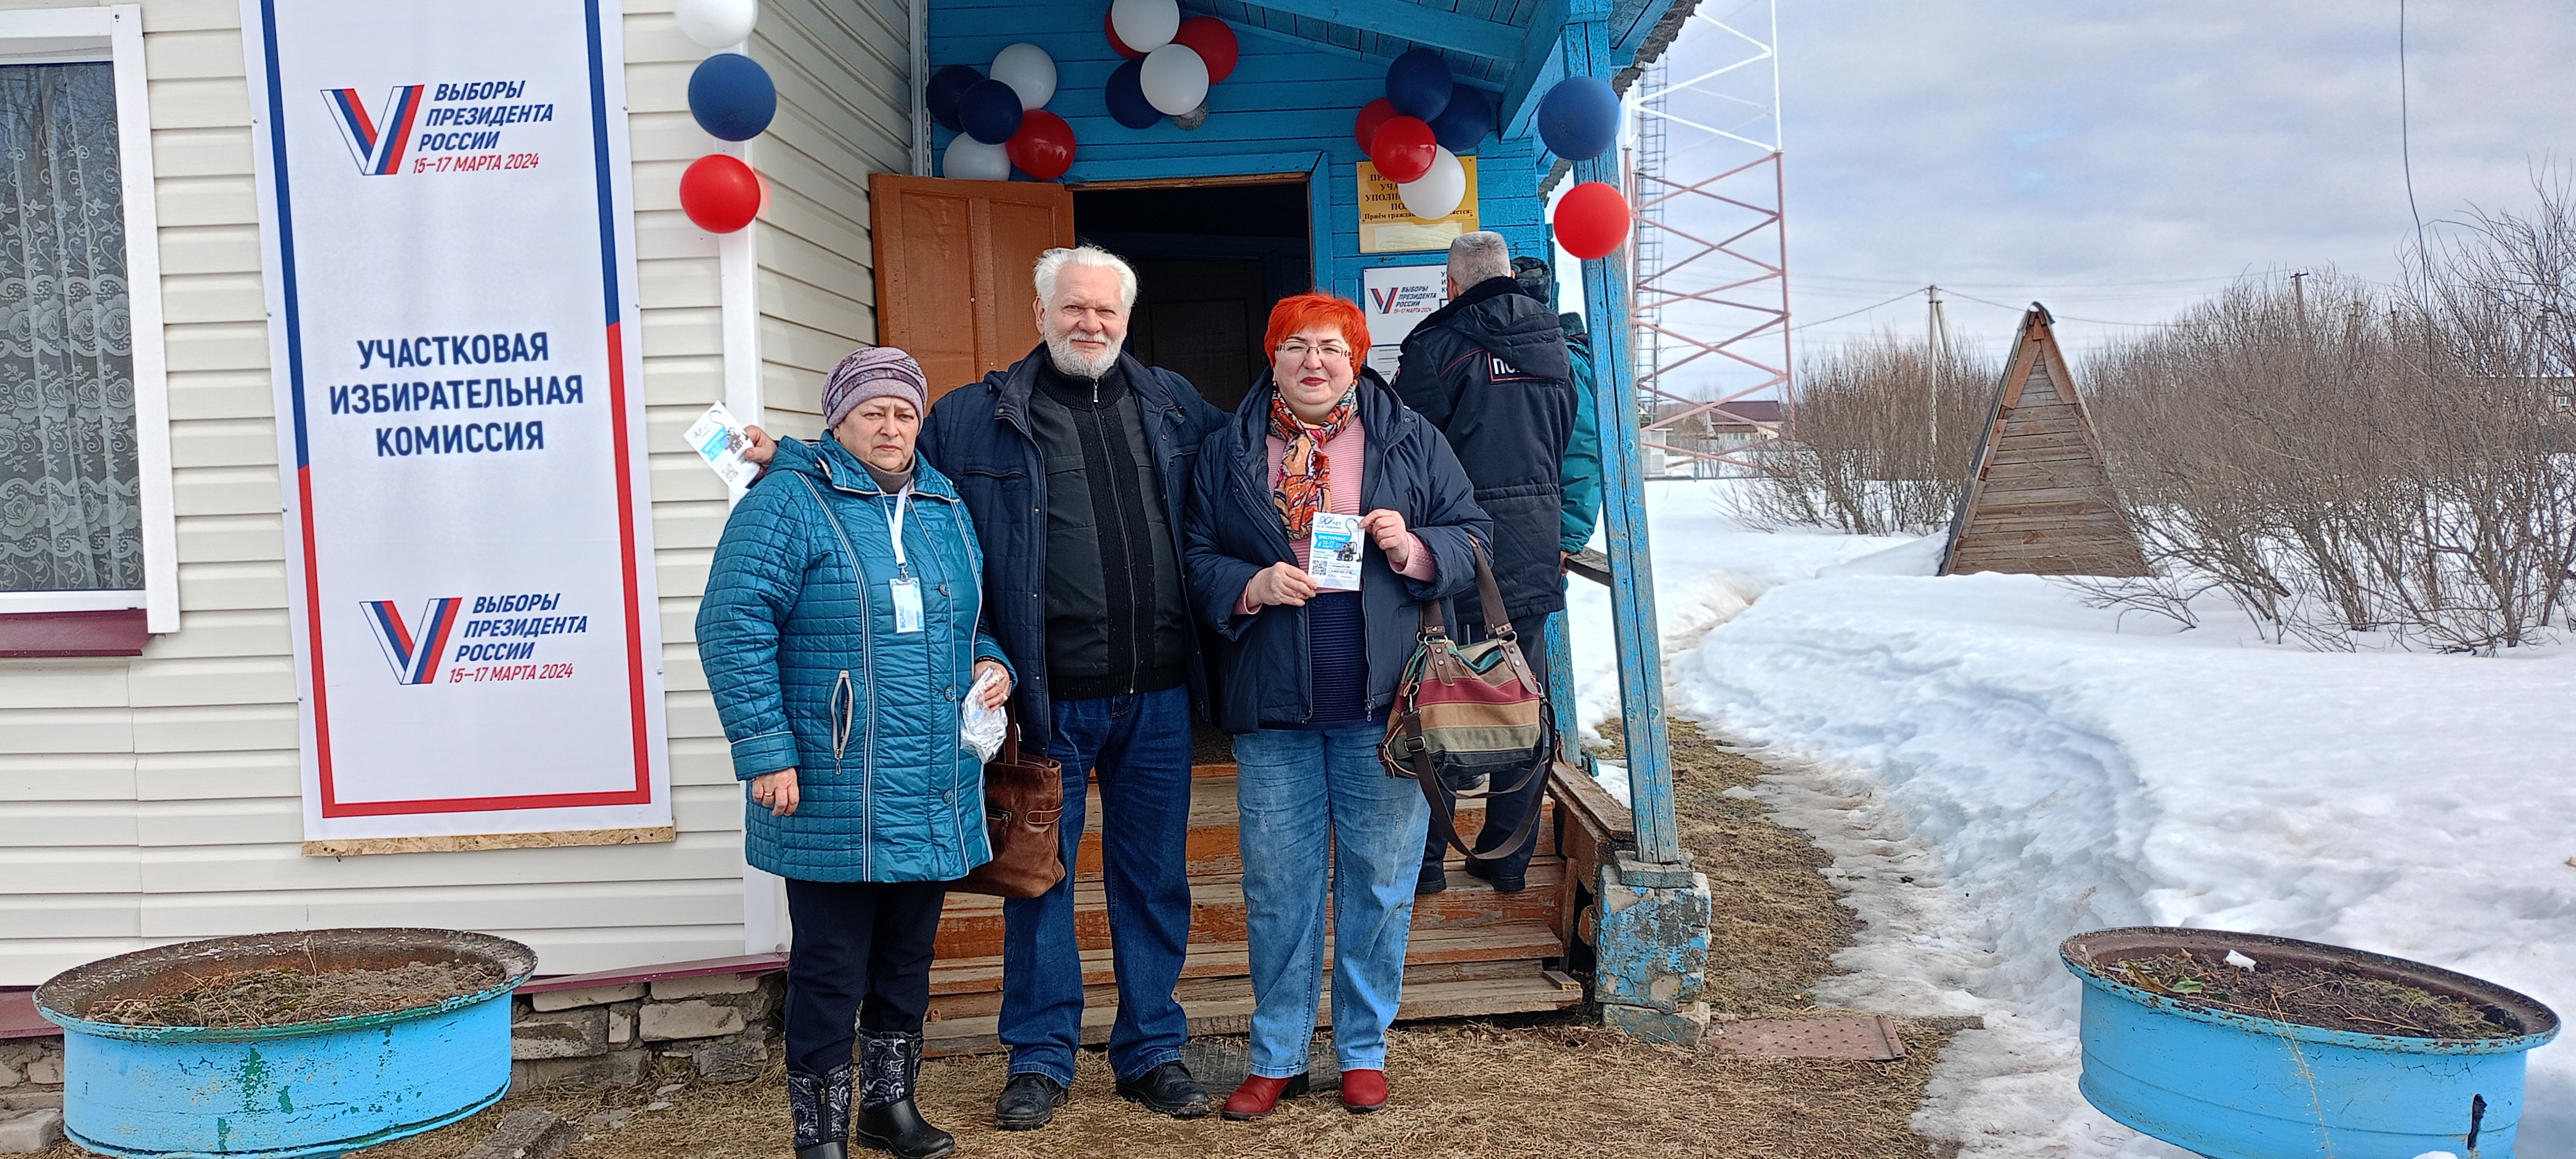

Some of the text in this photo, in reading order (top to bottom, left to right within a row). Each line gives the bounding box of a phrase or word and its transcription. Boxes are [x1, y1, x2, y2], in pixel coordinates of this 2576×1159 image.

[435, 80, 525, 101] ВЫБОРЫ
[426, 104, 553, 126] ПРЕЗИДЕНТА
[418, 132, 500, 152] РОССИИ
[453, 155, 502, 172] МАРТА
[504, 153, 539, 170] 2024
[357, 332, 548, 370] УЧАСТКОВАЯ
[330, 375, 583, 415] ИЗБИРАТЕЛЬНАЯ
[376, 421, 544, 456] КОМИССИЯ
[472, 593, 560, 613] ВЫБОРЫ
[464, 616, 587, 638] ПРЕЗИДЕНТА
[455, 642, 535, 662] РОССИИ
[490, 665, 536, 681] МАРТА
[539, 663, 573, 679] 2024
